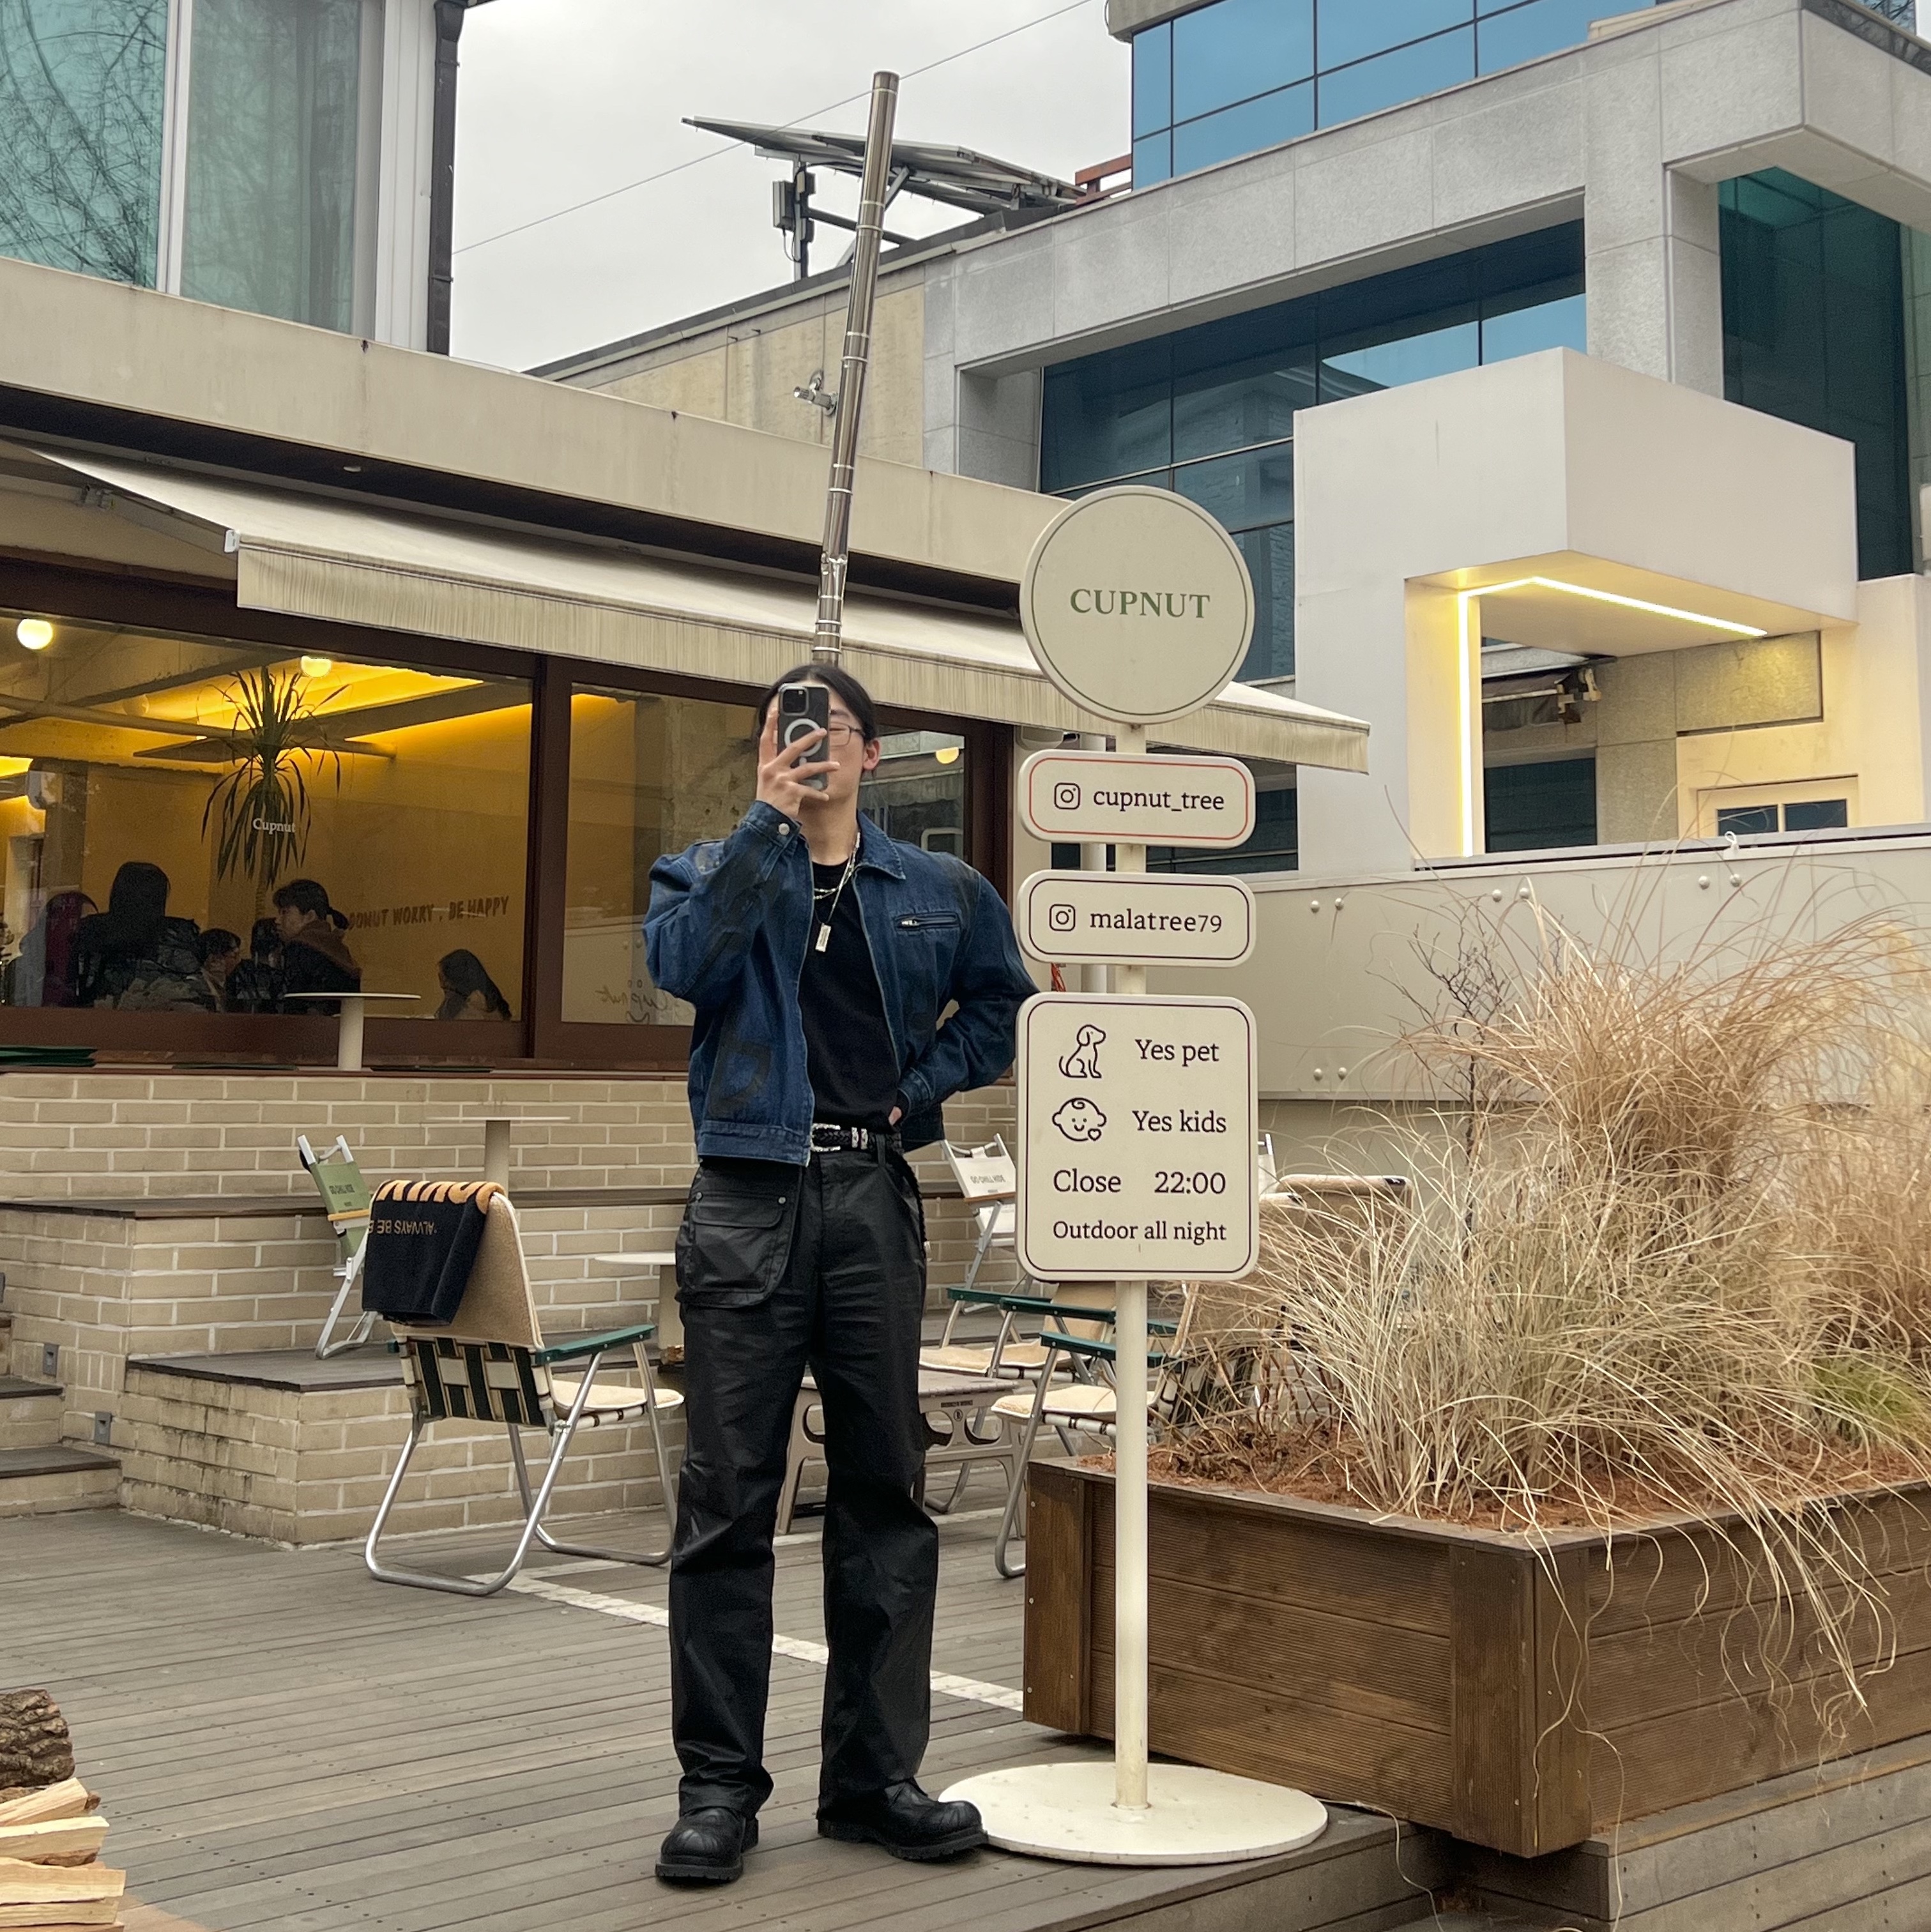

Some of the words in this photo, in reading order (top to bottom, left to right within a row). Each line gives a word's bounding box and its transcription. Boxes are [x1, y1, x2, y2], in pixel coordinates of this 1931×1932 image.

[1071, 589, 1210, 618] CUPNUT
[1093, 790, 1225, 812] cupnut_tree
[252, 818, 296, 833] Cupnut
[449, 900, 464, 920] BE
[467, 895, 509, 917] HAPPY
[1090, 908, 1221, 933] malatree79
[1135, 1039, 1175, 1060] Yes
[1182, 1044, 1219, 1067] pet
[1132, 1111, 1172, 1132] Yes
[1179, 1109, 1226, 1133] kids
[1053, 1168, 1121, 1193] Close
[1154, 1171, 1226, 1194] 22:00
[1053, 1220, 1138, 1239] Outdoor
[1145, 1221, 1167, 1239] all
[1173, 1221, 1226, 1245] night
